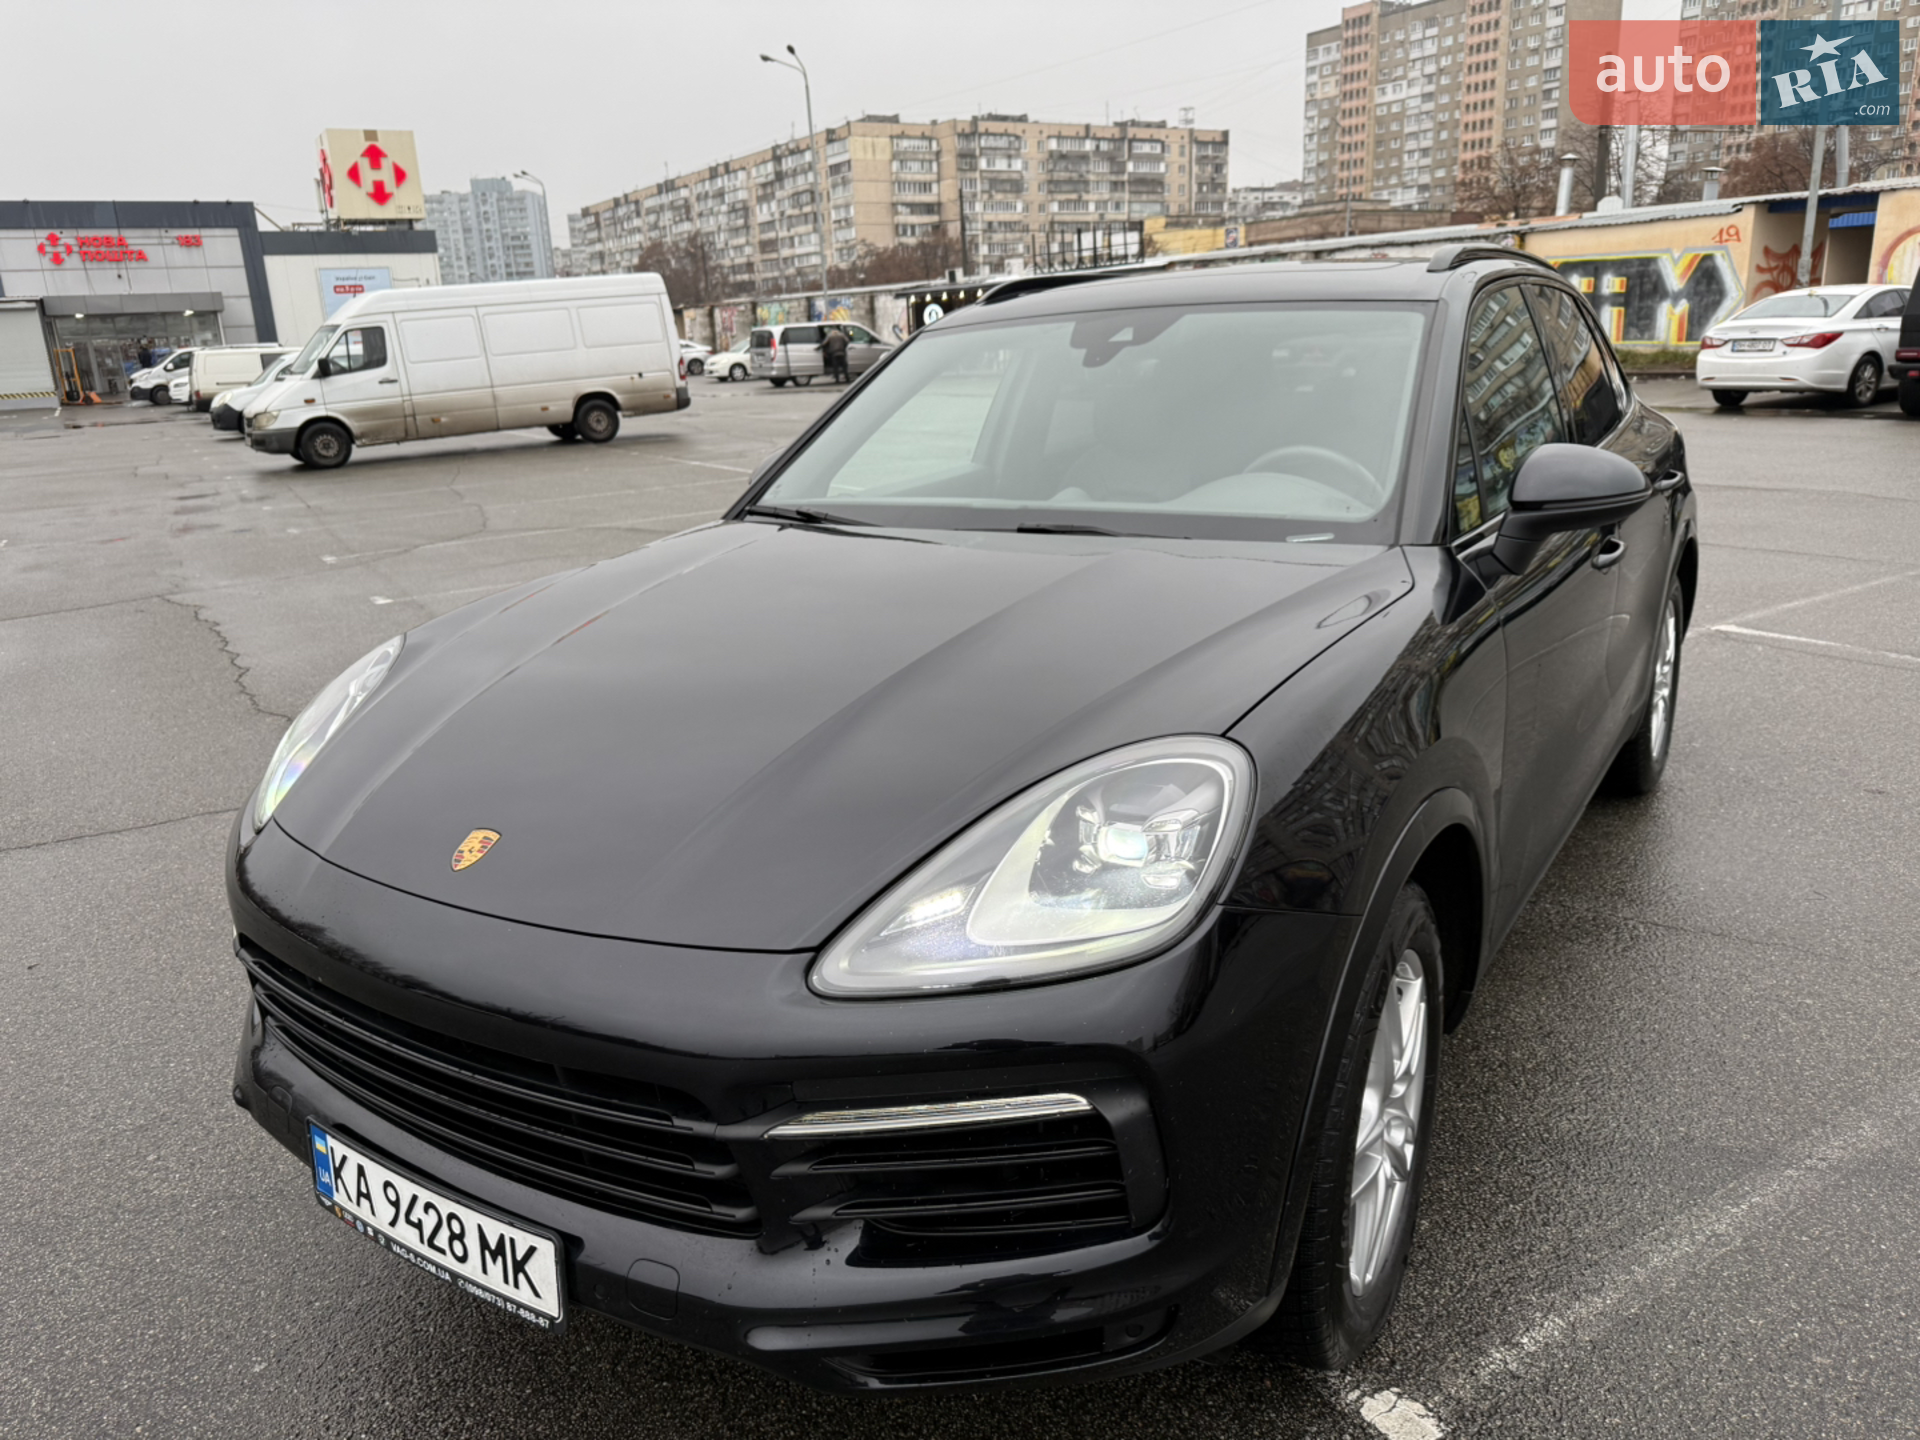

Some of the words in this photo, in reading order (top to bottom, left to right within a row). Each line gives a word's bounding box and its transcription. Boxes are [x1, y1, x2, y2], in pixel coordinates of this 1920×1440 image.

[76, 234, 129, 249] НОВА
[176, 234, 204, 248] 183
[79, 249, 149, 262] ПОШТА
[318, 1167, 332, 1187] UA
[330, 1145, 376, 1218] KA
[382, 1179, 469, 1264] 9428
[477, 1222, 542, 1299] MK
